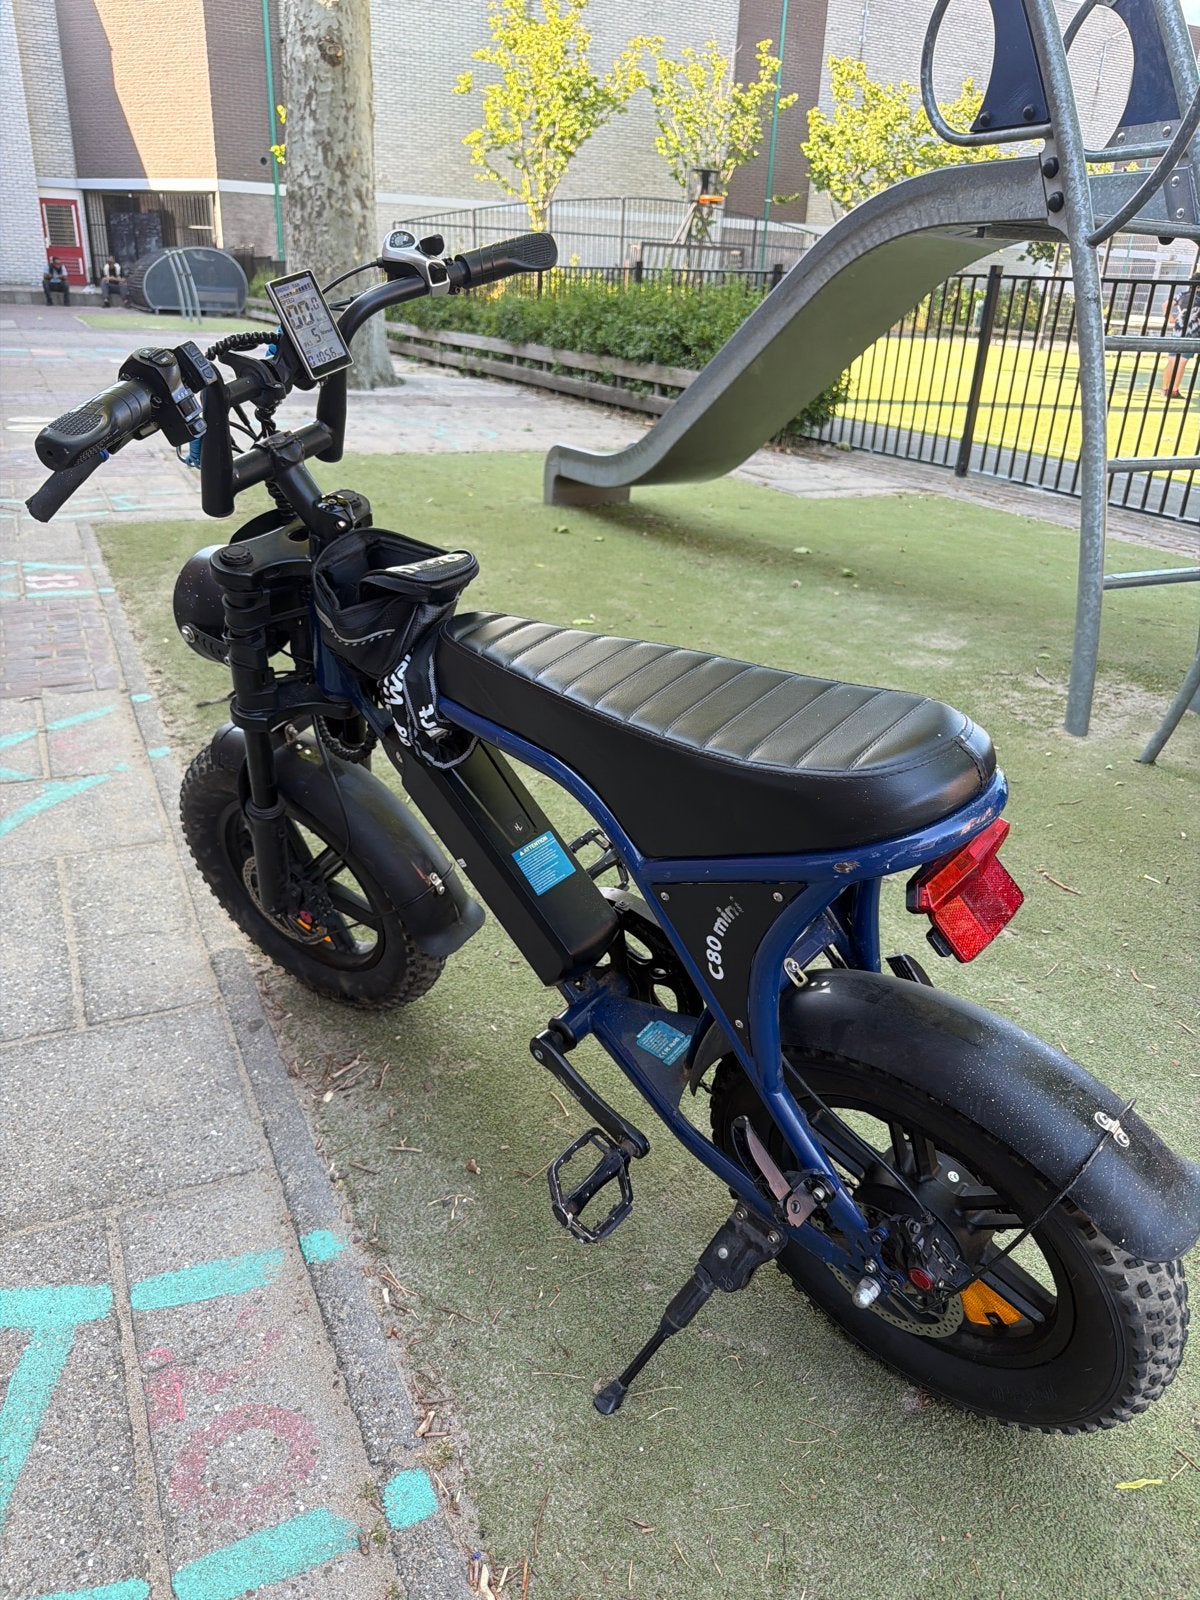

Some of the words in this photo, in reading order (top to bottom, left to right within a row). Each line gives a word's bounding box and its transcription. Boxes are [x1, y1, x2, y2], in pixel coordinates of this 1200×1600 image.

[281, 298, 295, 306] SPEED
[311, 327, 321, 342] 5
[523, 835, 549, 853] ATTENTION
[713, 896, 745, 937] mini
[706, 935, 724, 981] C80
